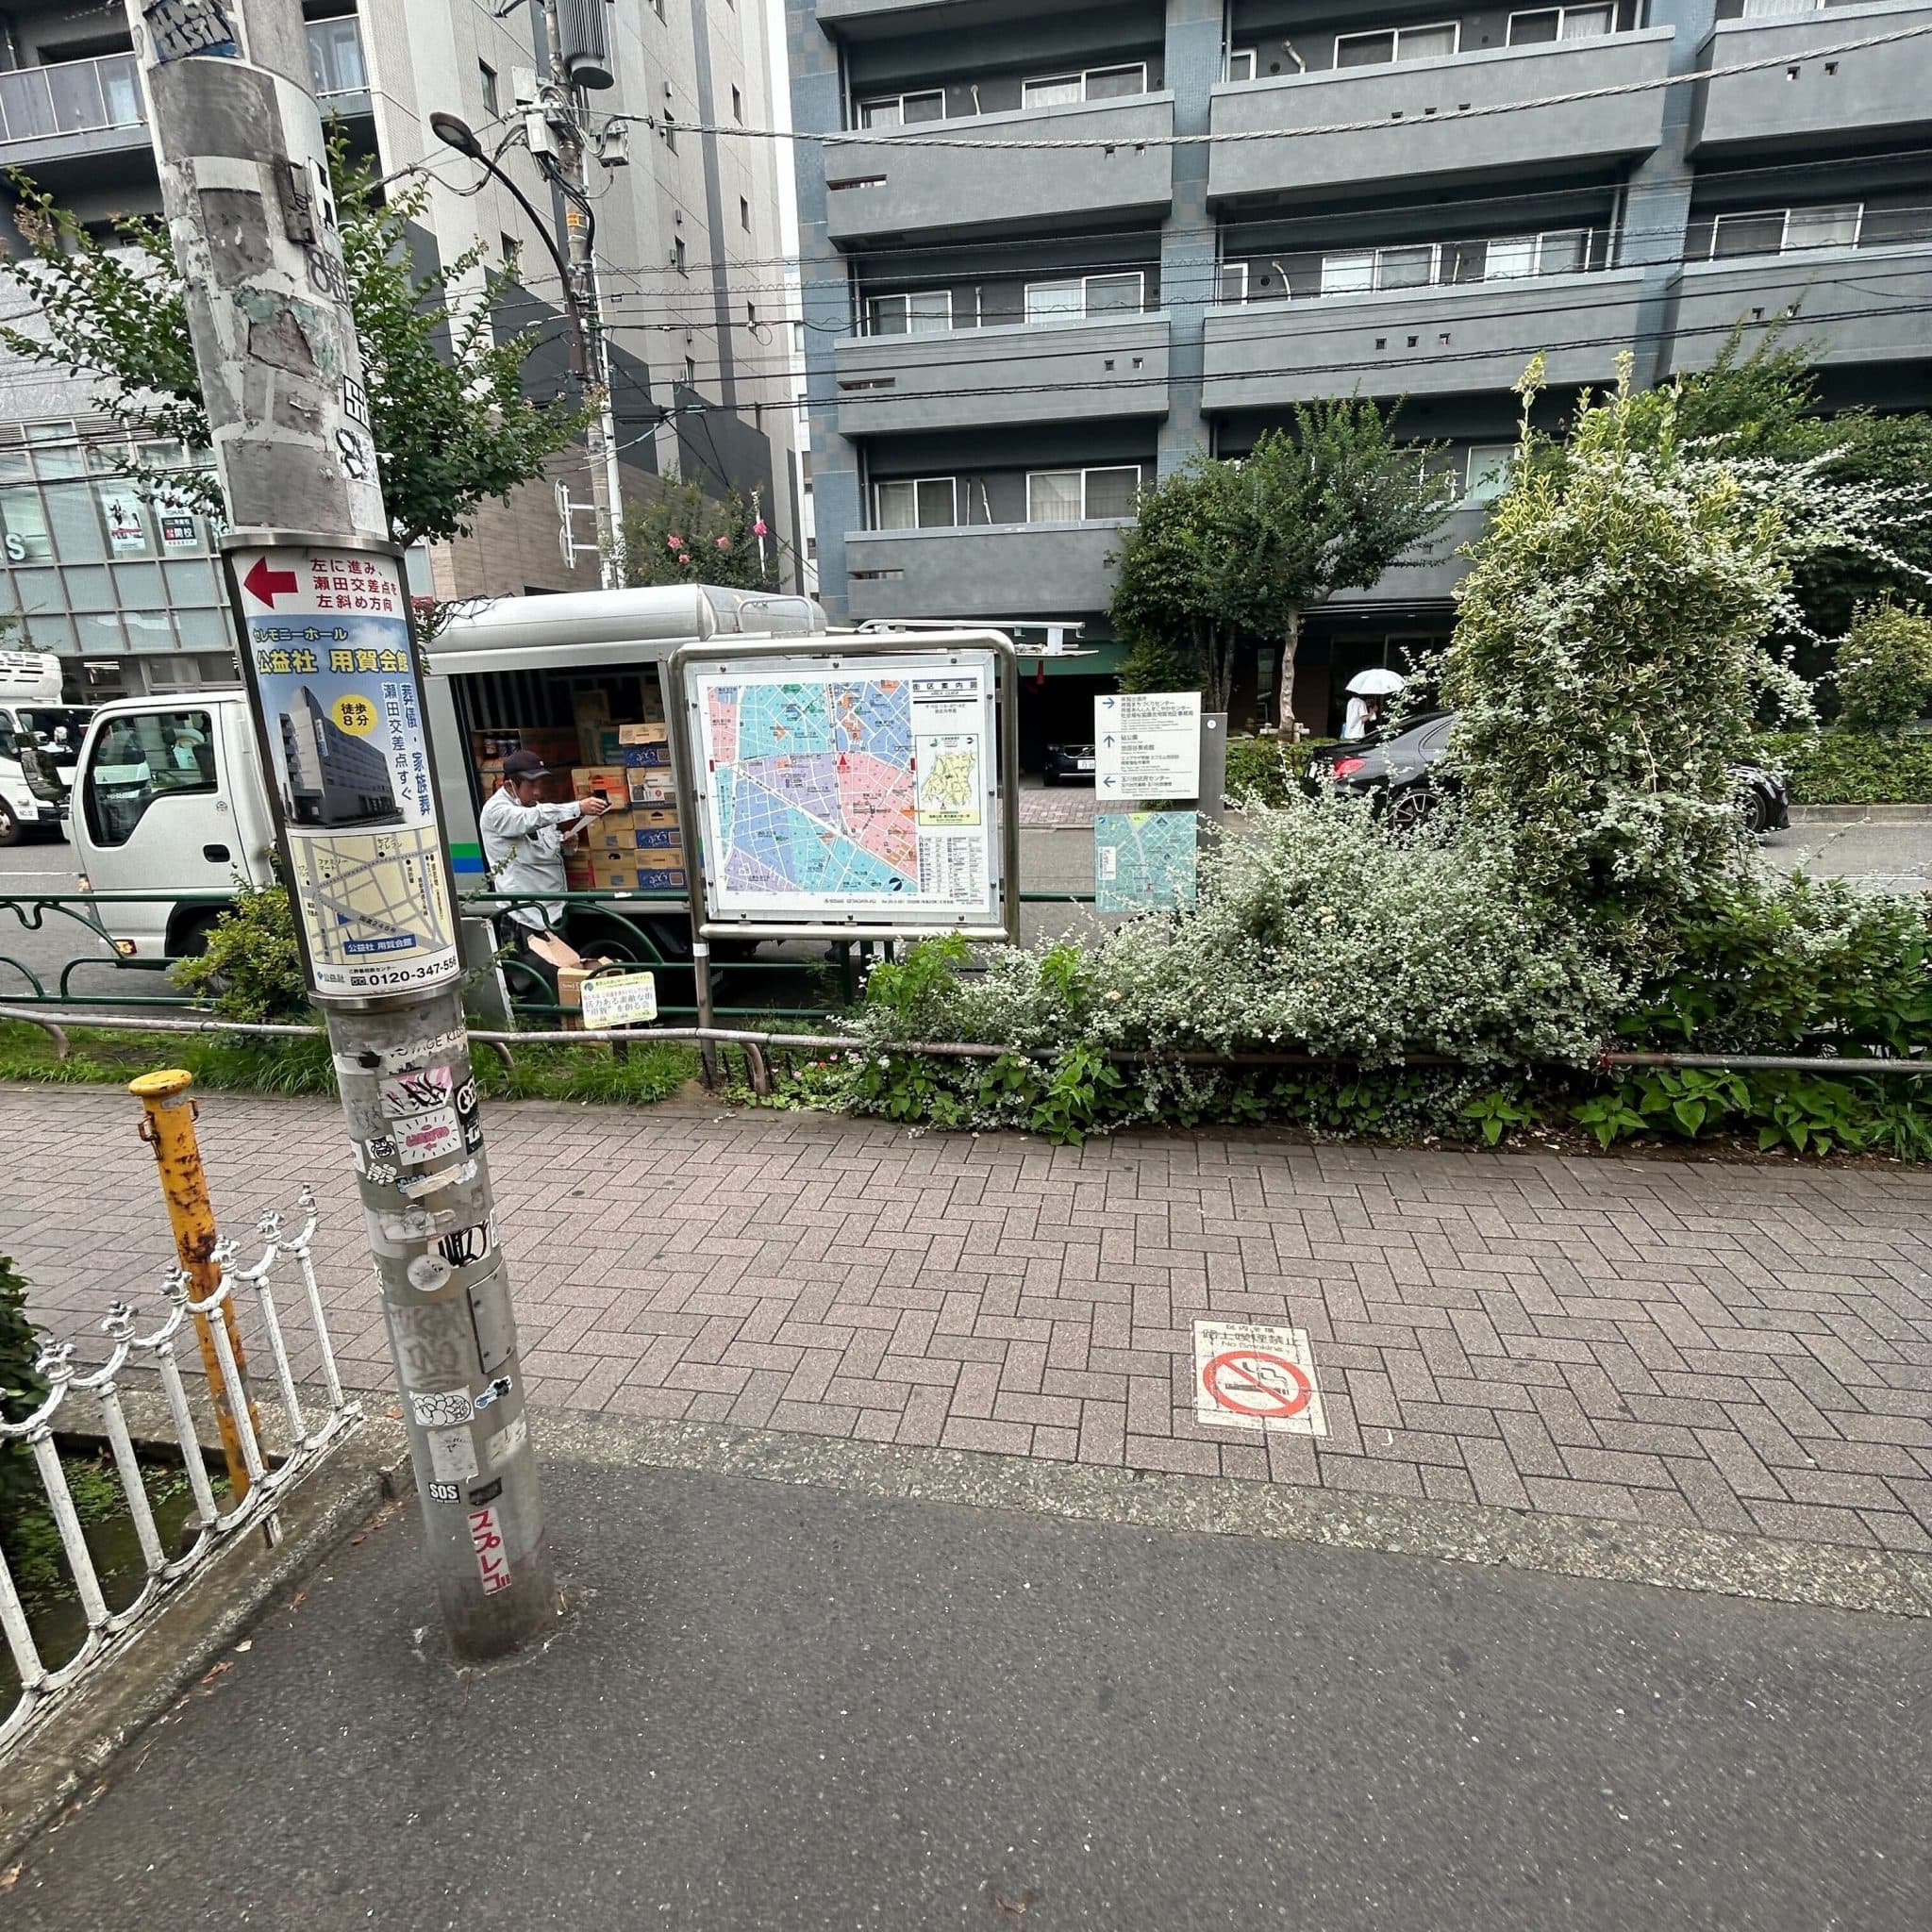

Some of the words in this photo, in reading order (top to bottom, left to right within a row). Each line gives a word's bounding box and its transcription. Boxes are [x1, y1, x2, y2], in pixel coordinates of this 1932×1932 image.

[0, 533, 25, 560] S
[310, 558, 383, 577] 左に進み、
[313, 576, 397, 595] 瀬田交差点を
[316, 594, 393, 611] 左斜め方向
[253, 627, 348, 642] セレモニーホール
[258, 649, 318, 675] 公益社
[329, 649, 409, 675] 用賀会館
[341, 703, 367, 716] 徒歩
[343, 715, 369, 726] 8分
[383, 683, 411, 801] 瀬田交差点すぐ
[348, 942, 375, 953] 公益社
[429, 1484, 458, 1500] SOS
